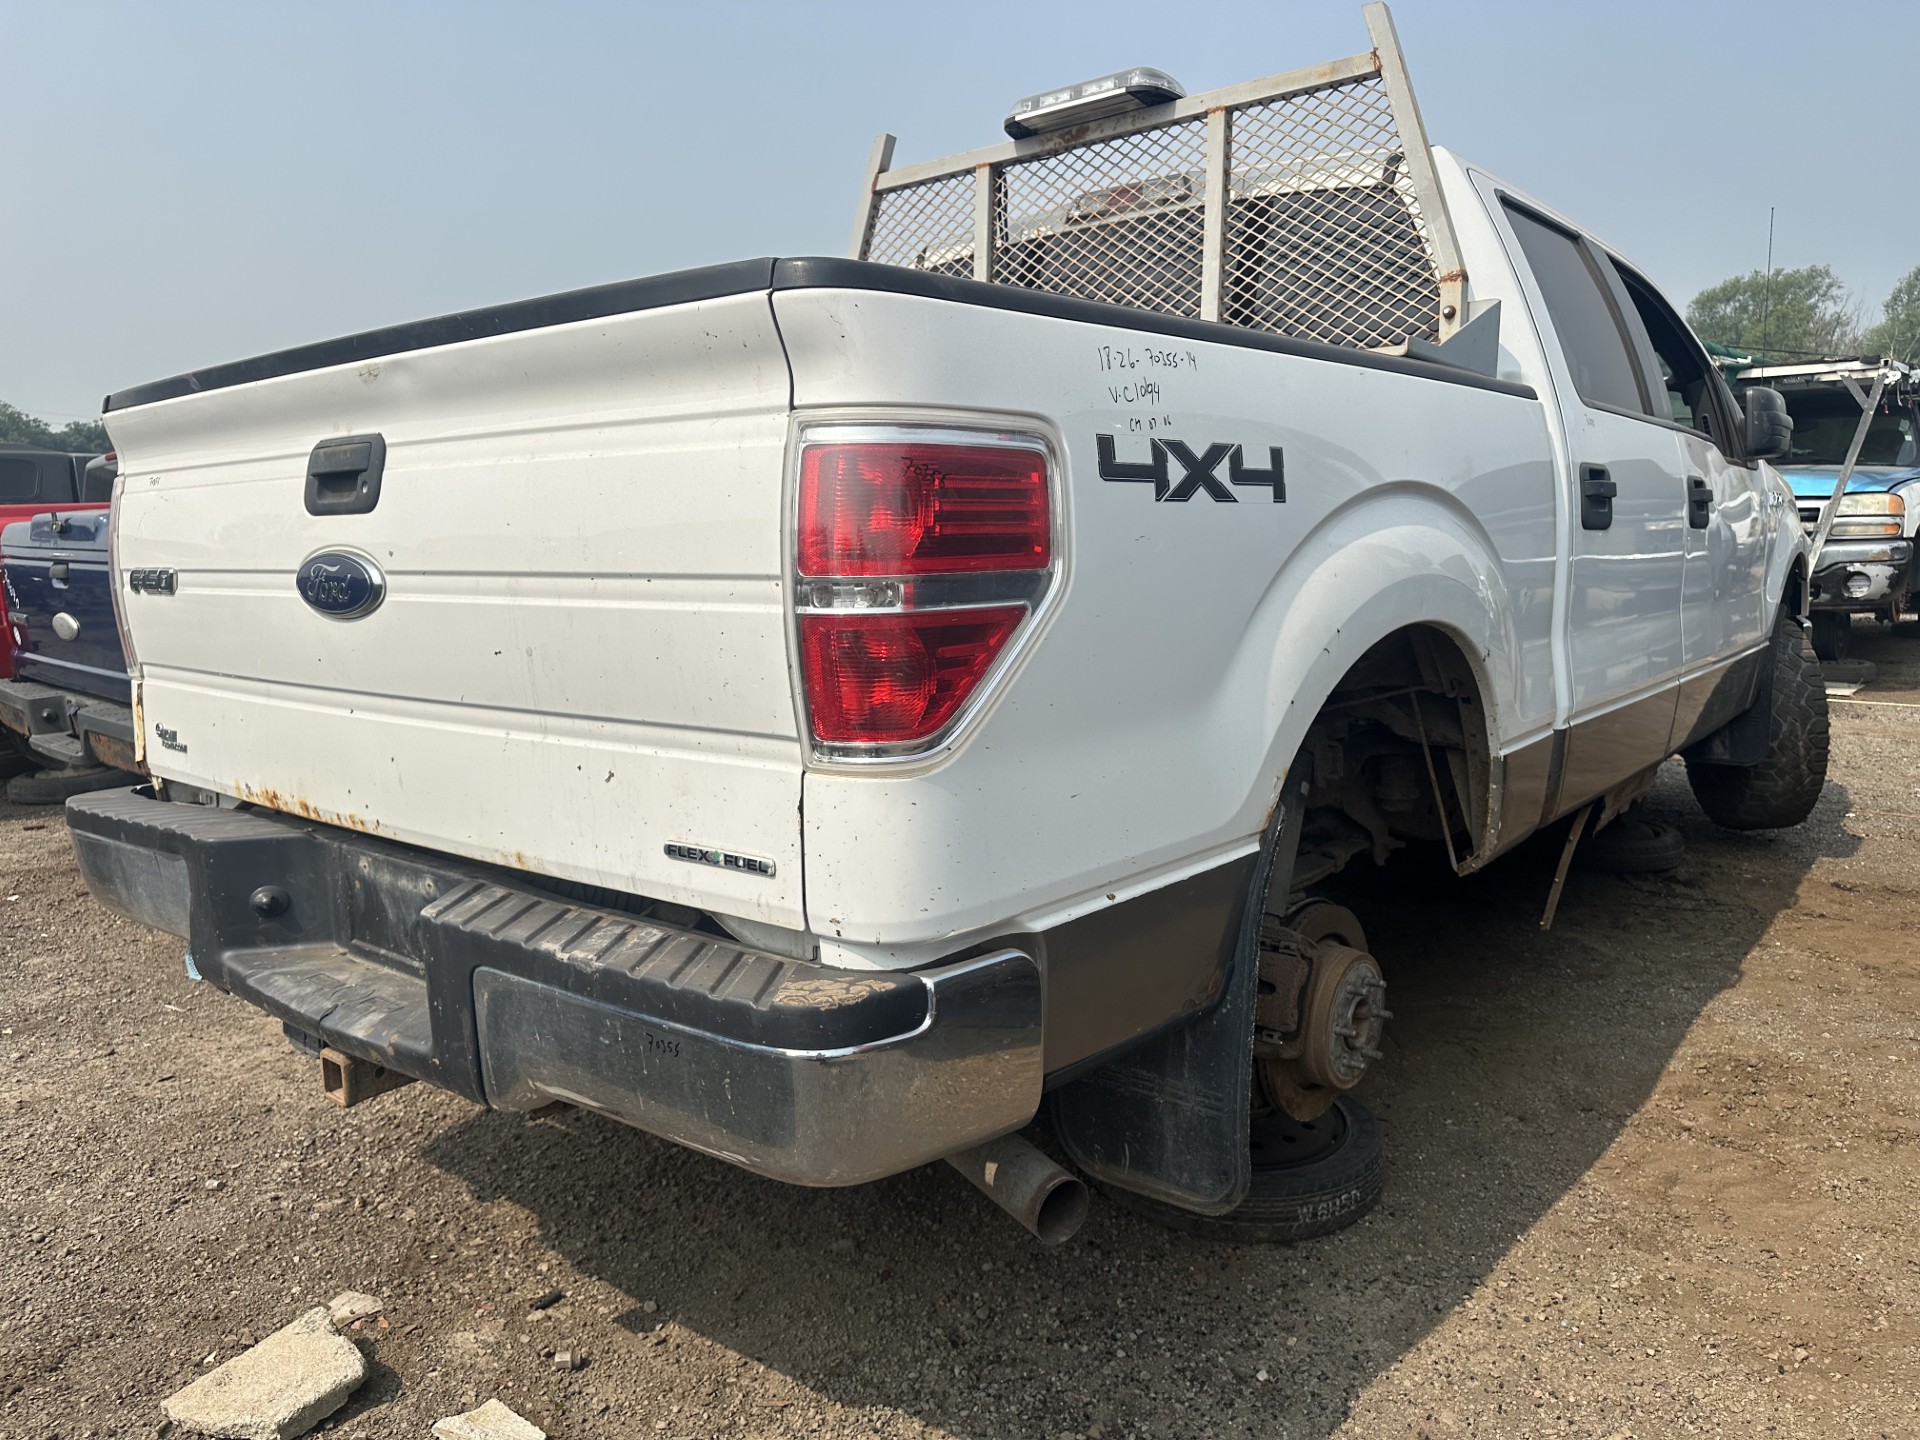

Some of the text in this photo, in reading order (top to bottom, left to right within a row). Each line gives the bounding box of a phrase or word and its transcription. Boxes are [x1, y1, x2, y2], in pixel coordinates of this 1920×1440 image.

[306, 563, 352, 602] Ford
[667, 844, 769, 874] FLEX FUEL
